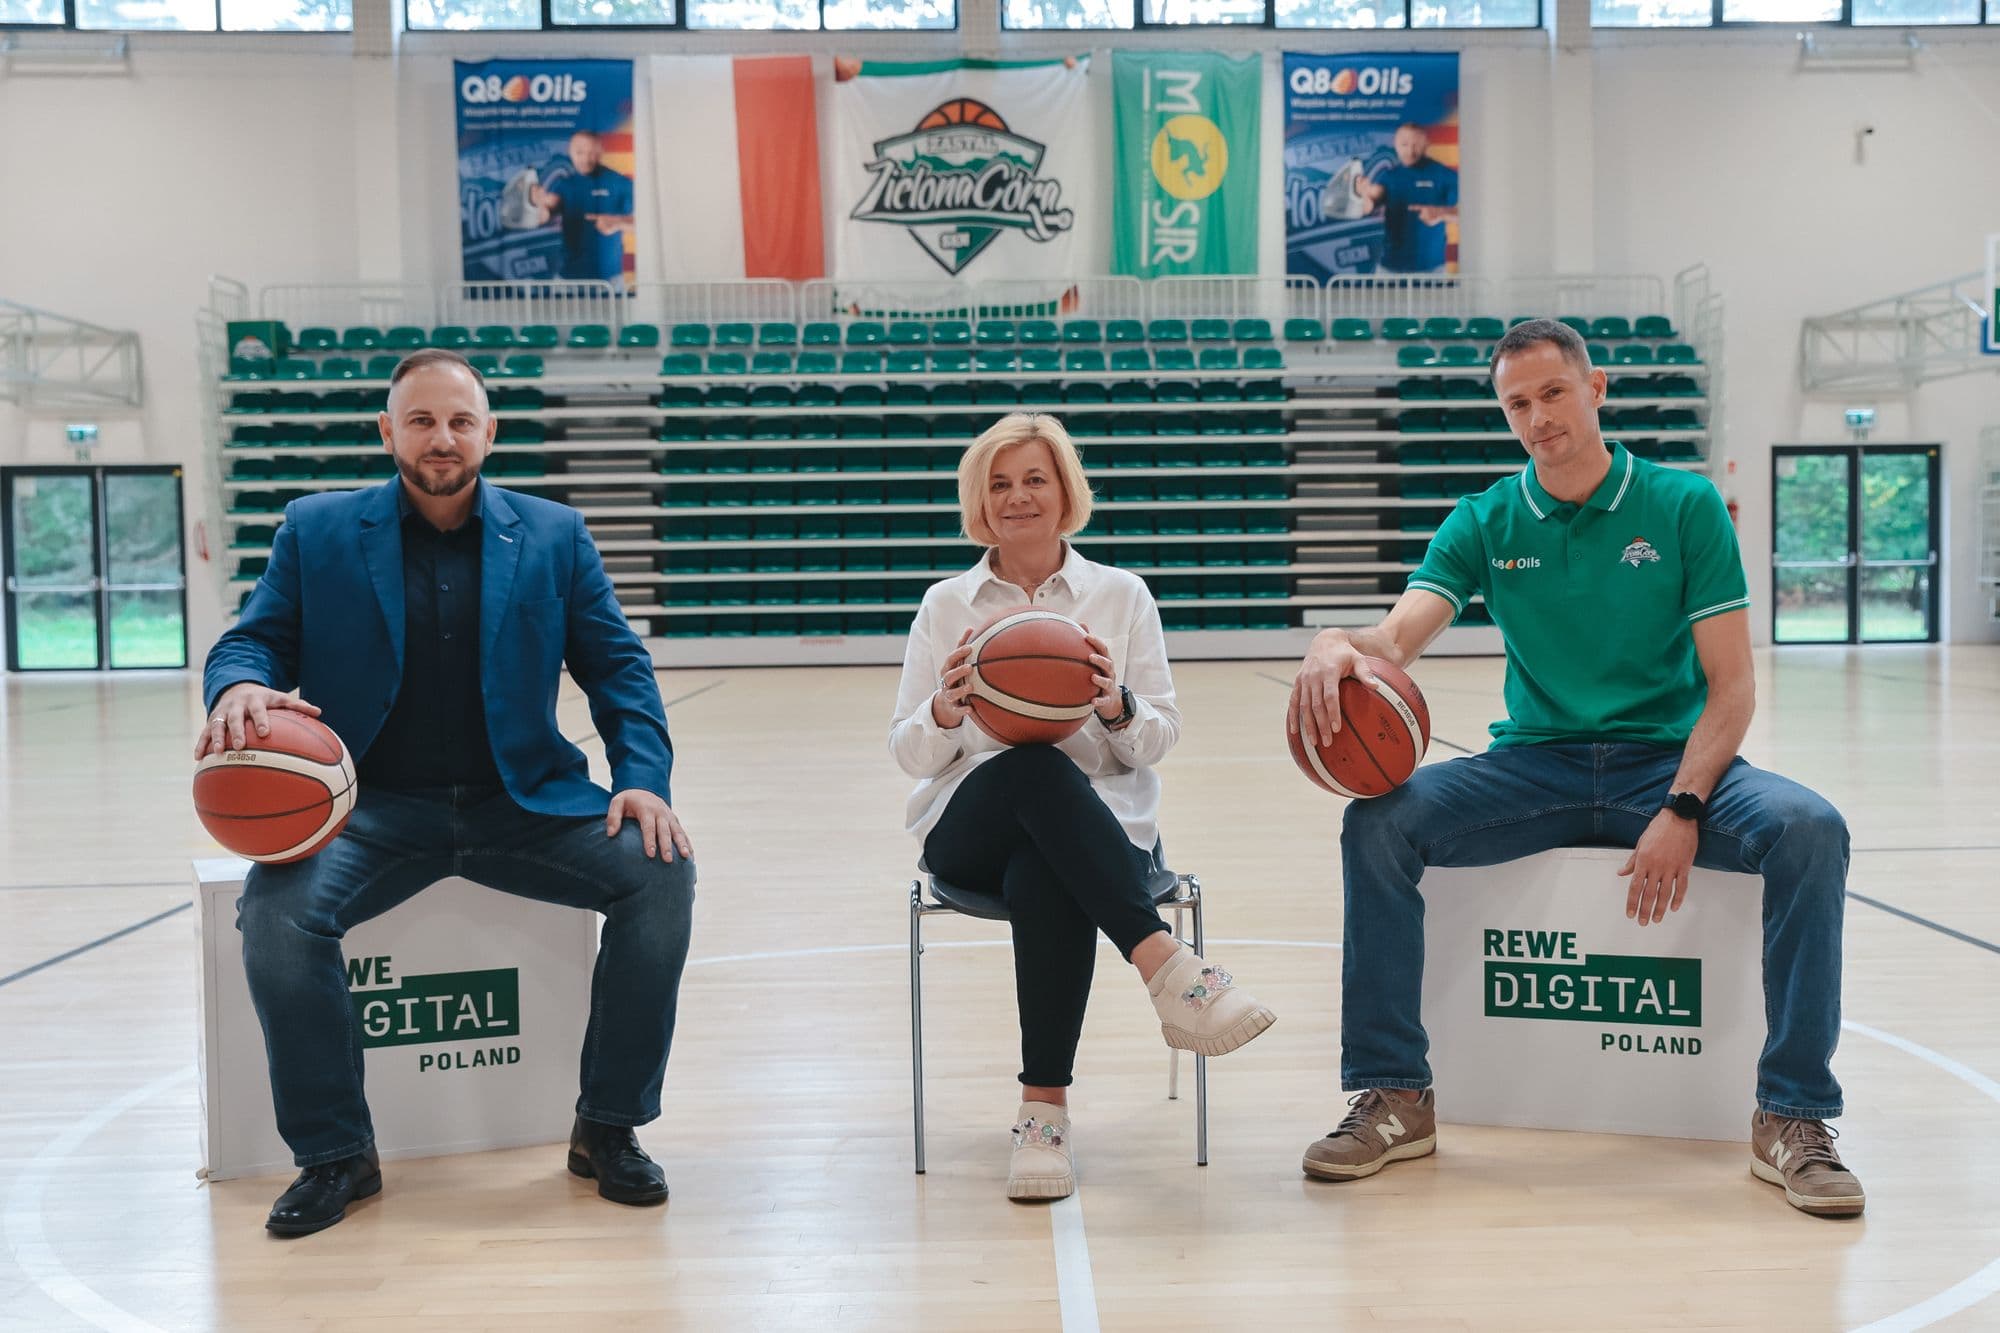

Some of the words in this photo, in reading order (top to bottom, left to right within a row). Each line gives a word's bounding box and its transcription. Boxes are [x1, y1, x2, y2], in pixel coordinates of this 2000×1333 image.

[462, 75, 502, 102] Q8
[530, 73, 586, 102] Oils
[1290, 67, 1330, 94] Q8
[1358, 67, 1413, 95] Oils
[1517, 557, 1541, 569] Oils
[1484, 929, 1578, 960] REWE
[348, 955, 393, 987] WE
[363, 991, 509, 1037] GITAL
[1601, 1033, 1702, 1056] POLAND
[419, 1046, 521, 1072] POLAND
